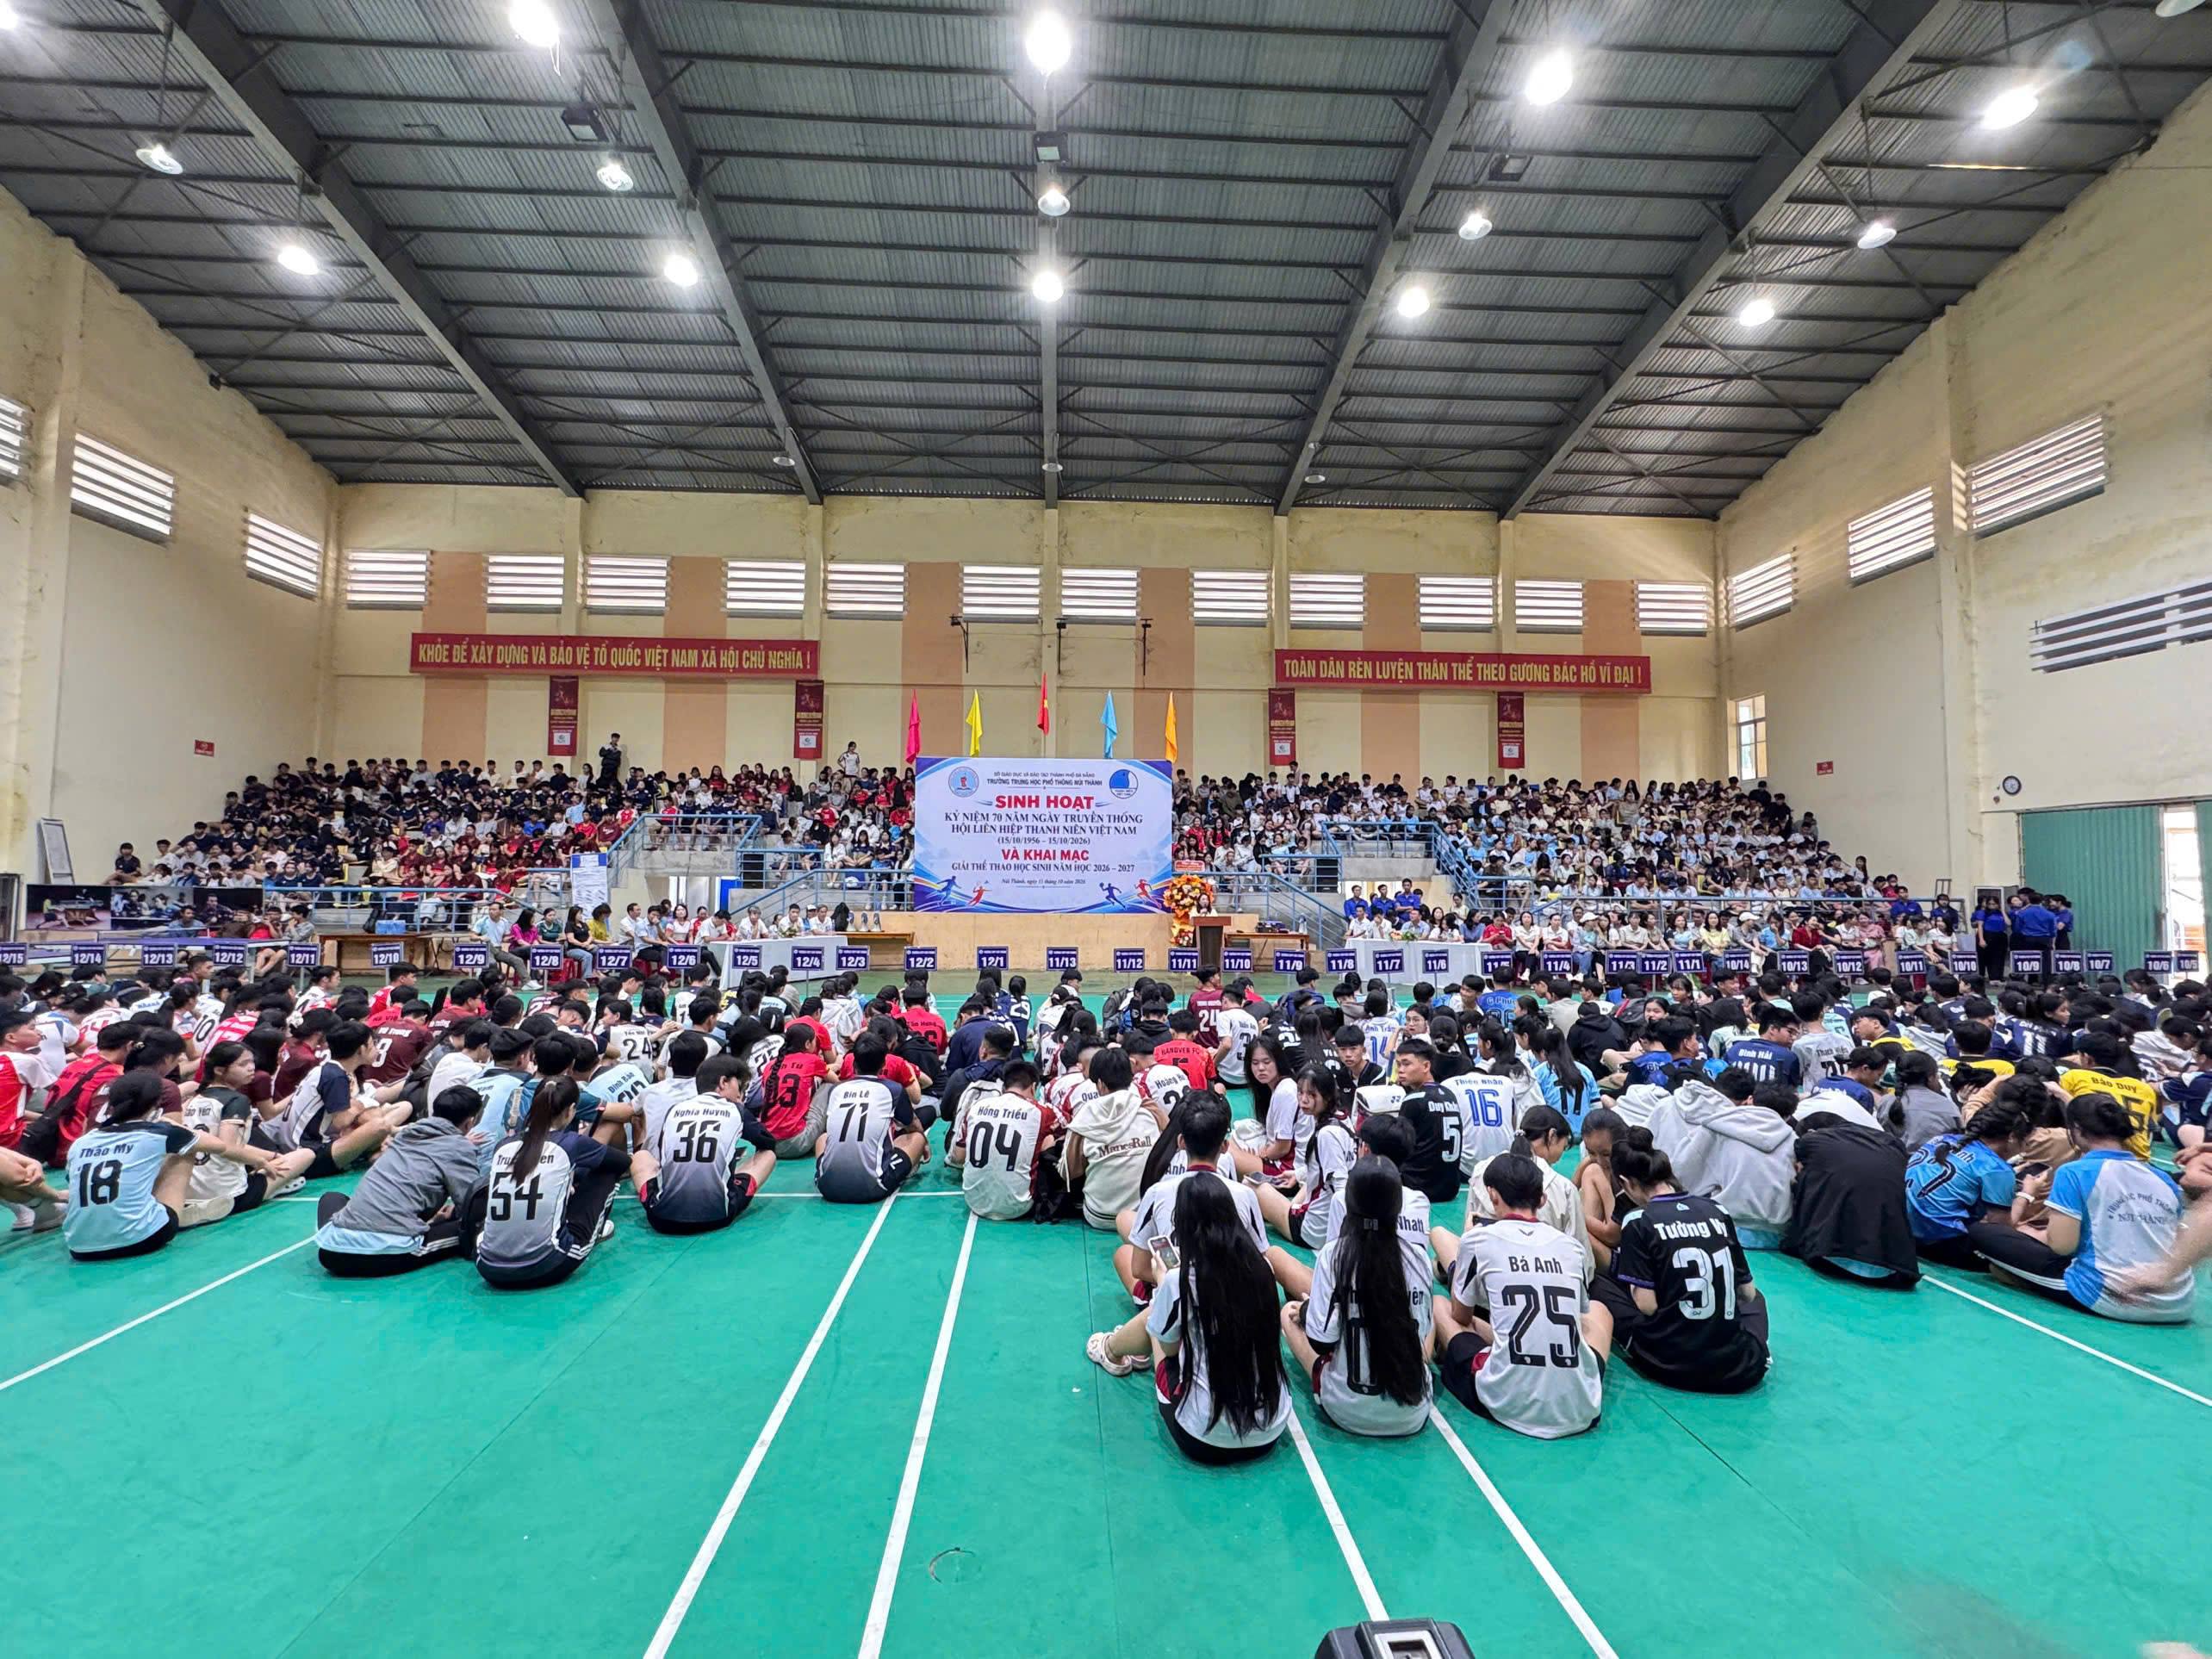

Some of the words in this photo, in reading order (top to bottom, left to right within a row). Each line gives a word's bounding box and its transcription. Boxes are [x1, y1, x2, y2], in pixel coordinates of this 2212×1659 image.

[419, 637, 450, 662] KHỎE
[452, 637, 469, 663] ĐỂ
[471, 641, 494, 663] XÂY
[496, 643, 529, 668] DỰNG
[531, 642, 547, 664] VÀ
[550, 640, 572, 665] BẢO
[576, 643, 590, 669] VỆ
[593, 640, 608, 666] TỔ
[610, 641, 642, 668] QUỐC
[644, 644, 668, 671] VIỆT
[671, 649, 699, 668] NAM
[701, 646, 717, 668] XÃ
[720, 646, 739, 673] HỘI
[743, 644, 765, 669] CHỦ
[768, 647, 804, 669] NGHĨA
[1283, 656, 1316, 679] TOÀN
[1320, 656, 1345, 679] DÂN
[1348, 656, 1372, 680] RÈN
[1376, 657, 1414, 683] LUYỆN
[1416, 658, 1448, 680] THÂN
[1451, 656, 1474, 681] THỂ
[1476, 663, 1506, 681] THEO
[1509, 662, 1550, 682] GƯƠNG
[1553, 662, 1577, 684] BÁC
[1581, 660, 1596, 683] HỒ
[1599, 662, 1611, 684] VĨ
[1614, 666, 1634, 687] ĐẠI
[995, 795, 1040, 808] SINH
[1046, 795, 1094, 811] HOẠT
[962, 811, 990, 823] NIỆM
[992, 813, 1002, 822] 70
[1005, 811, 1028, 823] NĂM
[1032, 811, 1060, 823] NGÀY
[1062, 811, 1103, 823] TRUYỀN
[1106, 811, 1143, 823] THỐNG
[952, 823, 970, 835] HỘI
[973, 823, 997, 834] LIÊN
[999, 823, 1022, 836] HIỆP
[1025, 825, 1060, 834] THANH
[1063, 824, 1086, 835] NIÊN
[1089, 824, 1113, 836] VIỆT
[1114, 826, 1137, 835] NAM
[1001, 847, 1020, 861] VÀ
[1023, 848, 1056, 861] KHAI
[1060, 849, 1090, 863] MẠC
[971, 860, 988, 871] THỂ
[989, 862, 1011, 871] THAO
[1014, 863, 1031, 873] HỌC
[1032, 863, 1052, 872] SINH
[1053, 863, 1072, 872] NĂM
[1074, 864, 1091, 873] HỌC
[73, 953, 102, 965] 12/14
[143, 953, 173, 965] 12/13
[214, 952, 244, 964] 12/12
[289, 953, 316, 965] 12/11
[374, 953, 399, 964] 12/10
[458, 954, 486, 966] 12/9
[534, 955, 560, 966] 12/8
[600, 954, 627, 966] 12/7
[670, 954, 697, 966] 12/6
[736, 954, 758, 966] 12/5
[796, 956, 822, 967] 12/4
[841, 955, 866, 967] 12/3
[909, 955, 934, 967] 12/2
[981, 955, 1005, 967] 12/1
[1048, 956, 1076, 968] 11/13
[1116, 958, 1143, 969] 11/12
[1171, 958, 1198, 969] 11/11
[1224, 958, 1251, 969] 11/10
[1277, 959, 1302, 971] 11/9
[1330, 959, 1354, 970] 11/8
[1376, 959, 1401, 971] 11/7
[1427, 959, 1446, 970] 11/6
[1546, 960, 1570, 971] 11/4
[1644, 960, 1668, 971] 11/2
[1678, 959, 1701, 970] 11/1
[1726, 960, 1749, 970] 10/14
[1781, 961, 1807, 972] 10/13
[1836, 961, 1862, 972] 10/12
[1900, 961, 1923, 972] 10/11
[1953, 961, 1976, 972] 10/10
[2016, 961, 2040, 972] 10/9
[2058, 960, 2080, 972] 10/8
[2089, 960, 2110, 969] 10/7
[2147, 960, 2169, 971] 10/6
[623, 1037, 652, 1061] 24
[1428, 1101, 1445, 1113] Duy
[1465, 1089, 1503, 1127] 16
[839, 1103, 870, 1142] 71
[673, 1120, 722, 1163] 36
[1442, 1116, 1462, 1162] 5
[970, 1121, 1022, 1171] 04
[78, 1159, 123, 1207] 18
[491, 1171, 544, 1221] 54
[1508, 1255, 1529, 1273] Bá
[1534, 1255, 1563, 1275] Anh
[1672, 1246, 1736, 1320] 31
[1502, 1283, 1581, 1368] 25
